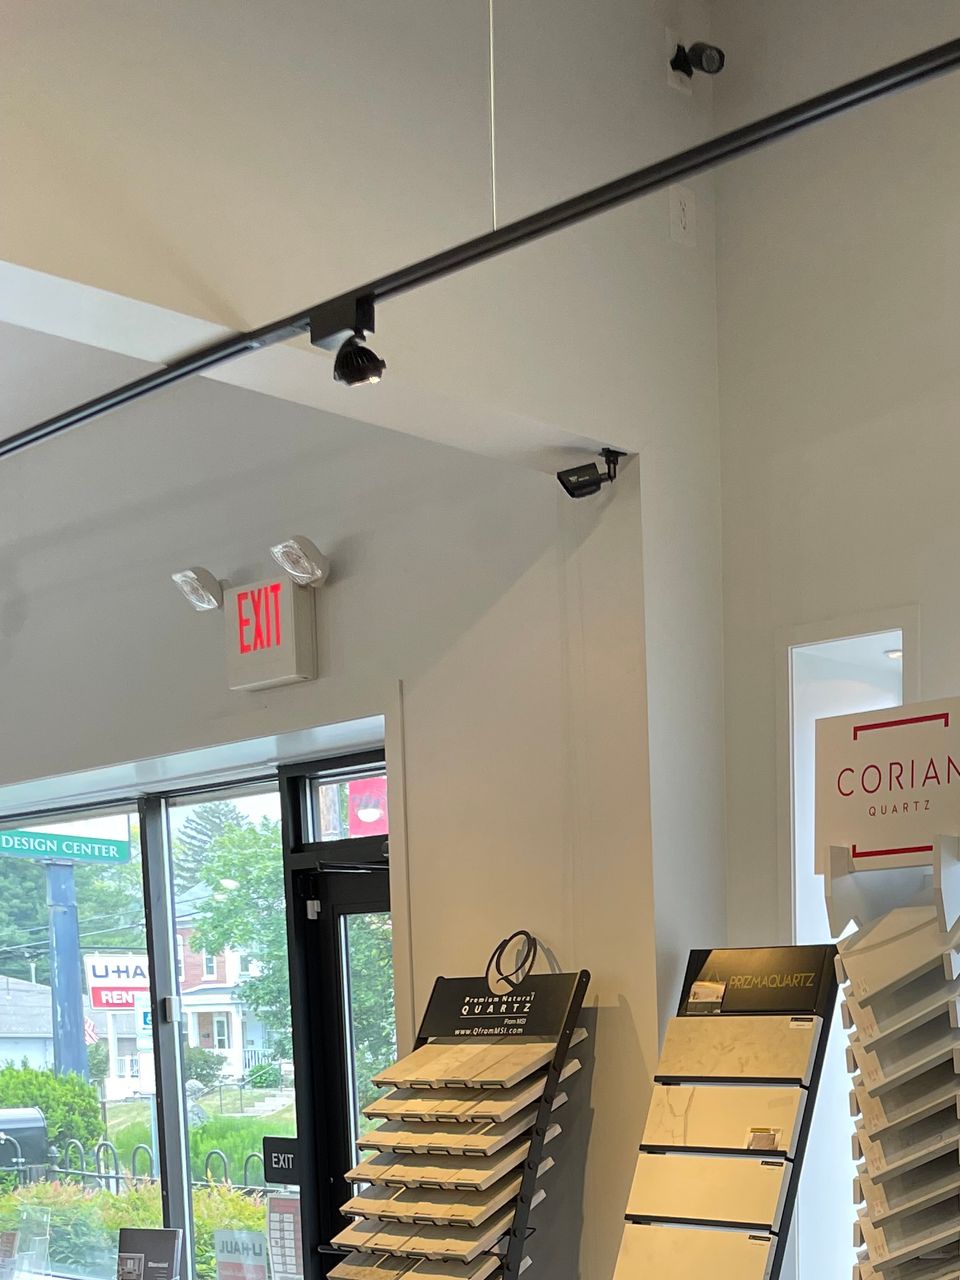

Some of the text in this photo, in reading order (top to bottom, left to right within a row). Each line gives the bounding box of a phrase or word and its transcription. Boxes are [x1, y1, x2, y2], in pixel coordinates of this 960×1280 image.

[236, 582, 282, 655] EXIT
[868, 799, 931, 817] QUARTZ
[1, 834, 119, 858] DESIGN CENTER
[92, 965, 147, 979] U-HA
[729, 973, 816, 989] PRIZMAQUARTZ
[464, 996, 499, 1004] Premium
[461, 1003, 532, 1015] QUARTZ
[272, 1153, 294, 1169] EXIT
